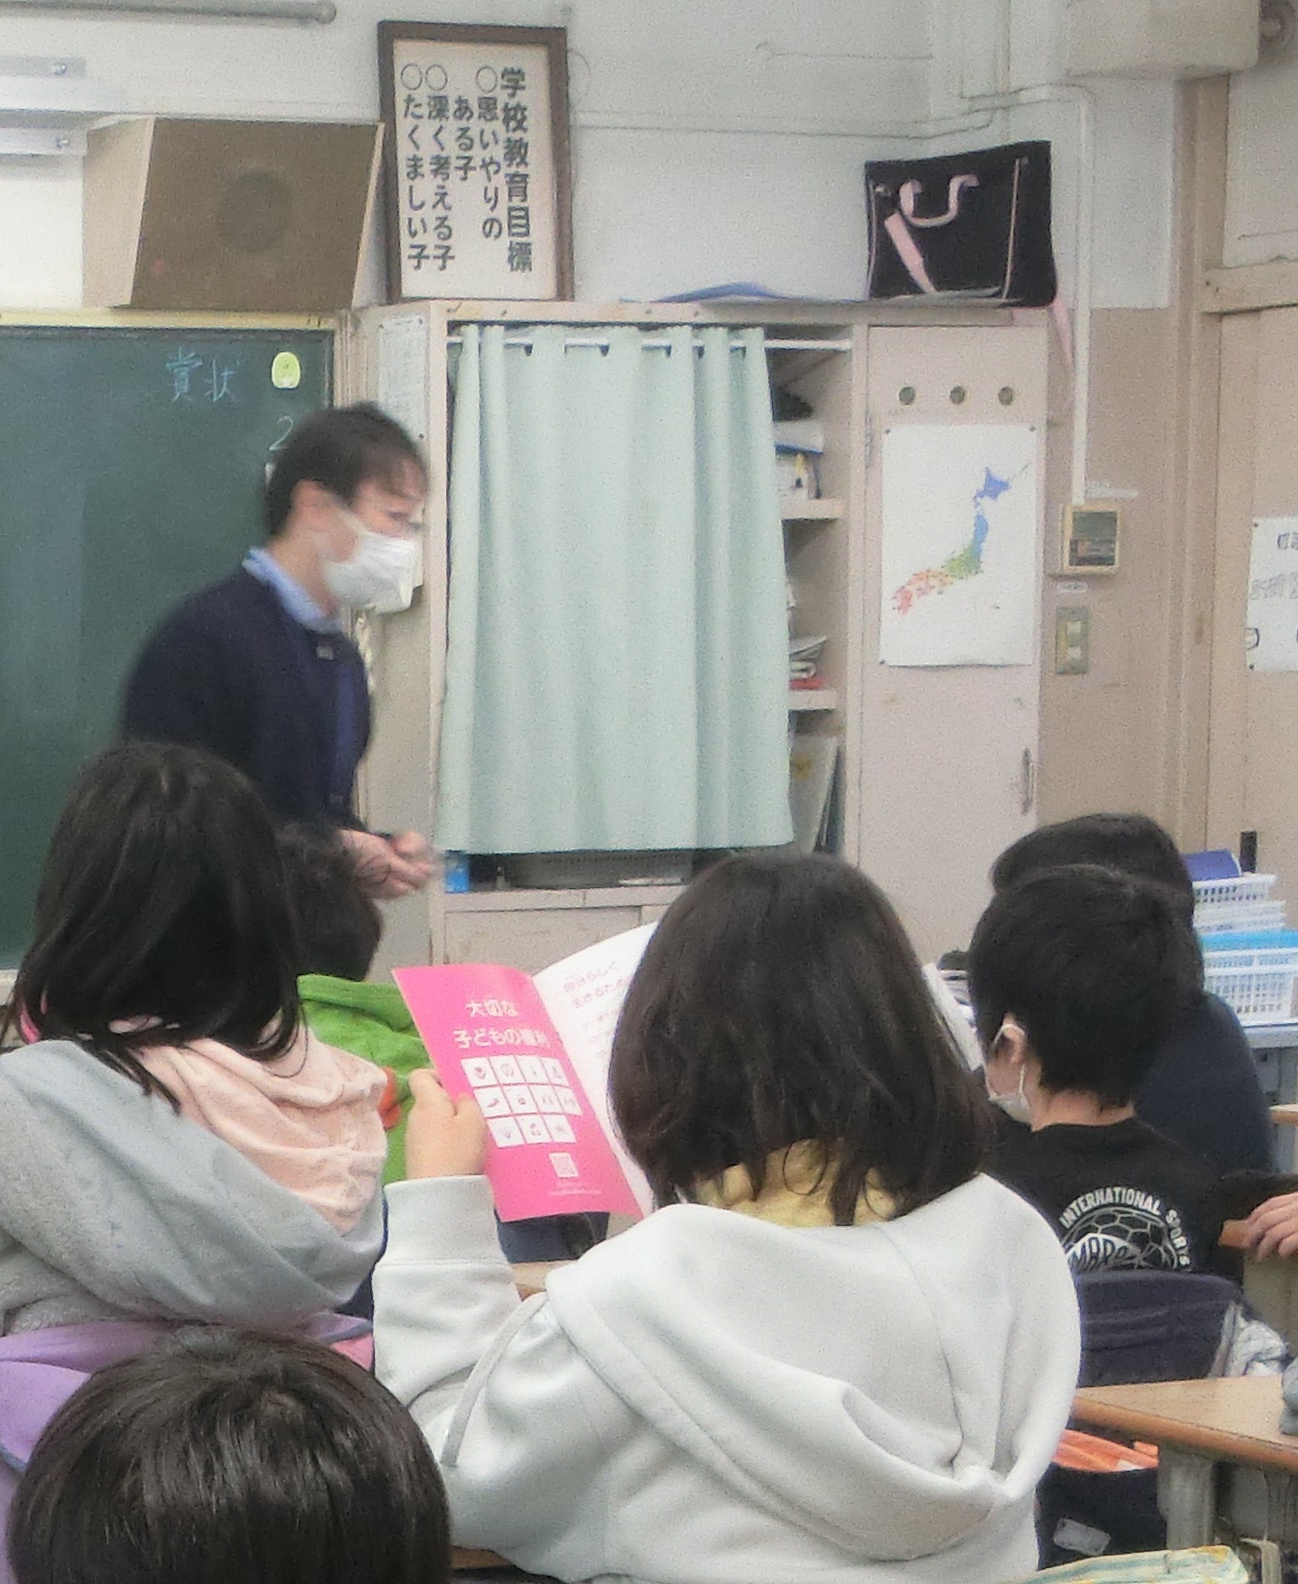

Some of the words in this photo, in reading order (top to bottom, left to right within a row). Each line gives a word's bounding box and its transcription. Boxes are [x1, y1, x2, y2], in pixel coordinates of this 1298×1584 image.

[453, 96, 477, 182] ある子
[500, 66, 533, 273] 学校教育目標
[165, 346, 242, 403] 賞状
[465, 999, 520, 1018] 大切な
[1059, 1186, 1162, 1230] INTERNATIONAL
